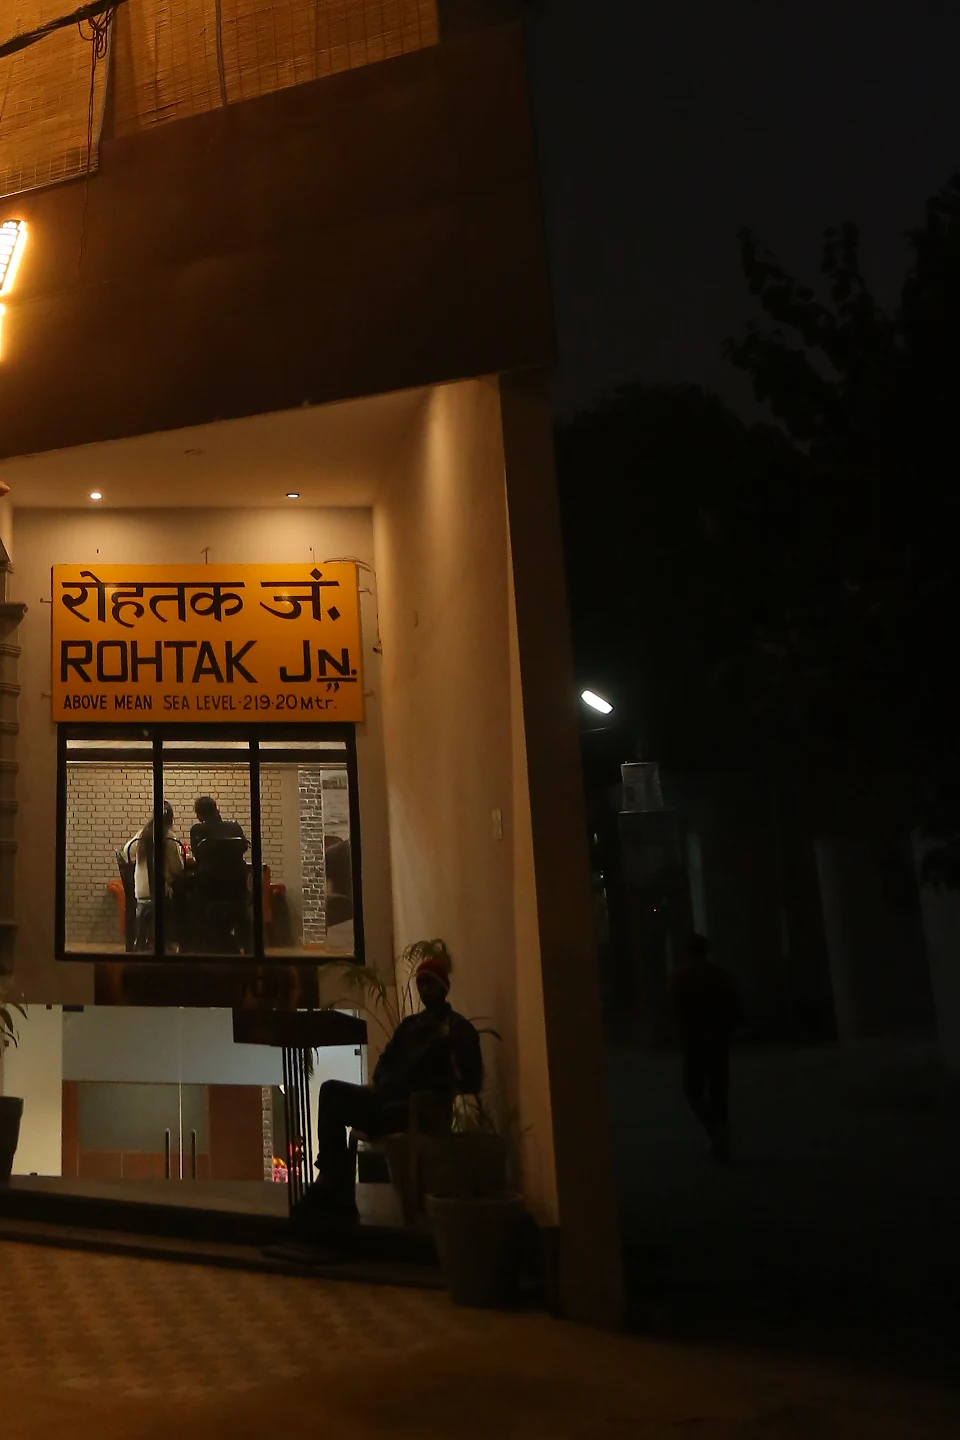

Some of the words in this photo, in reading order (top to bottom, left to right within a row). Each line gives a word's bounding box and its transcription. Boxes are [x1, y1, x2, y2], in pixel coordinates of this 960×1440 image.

[61, 570, 246, 628] रोहतक
[260, 568, 341, 621] जं.
[60, 640, 258, 683] ROHTAK
[64, 694, 108, 710] ABOVE
[114, 694, 152, 710] MEAN
[164, 694, 190, 710] SEA
